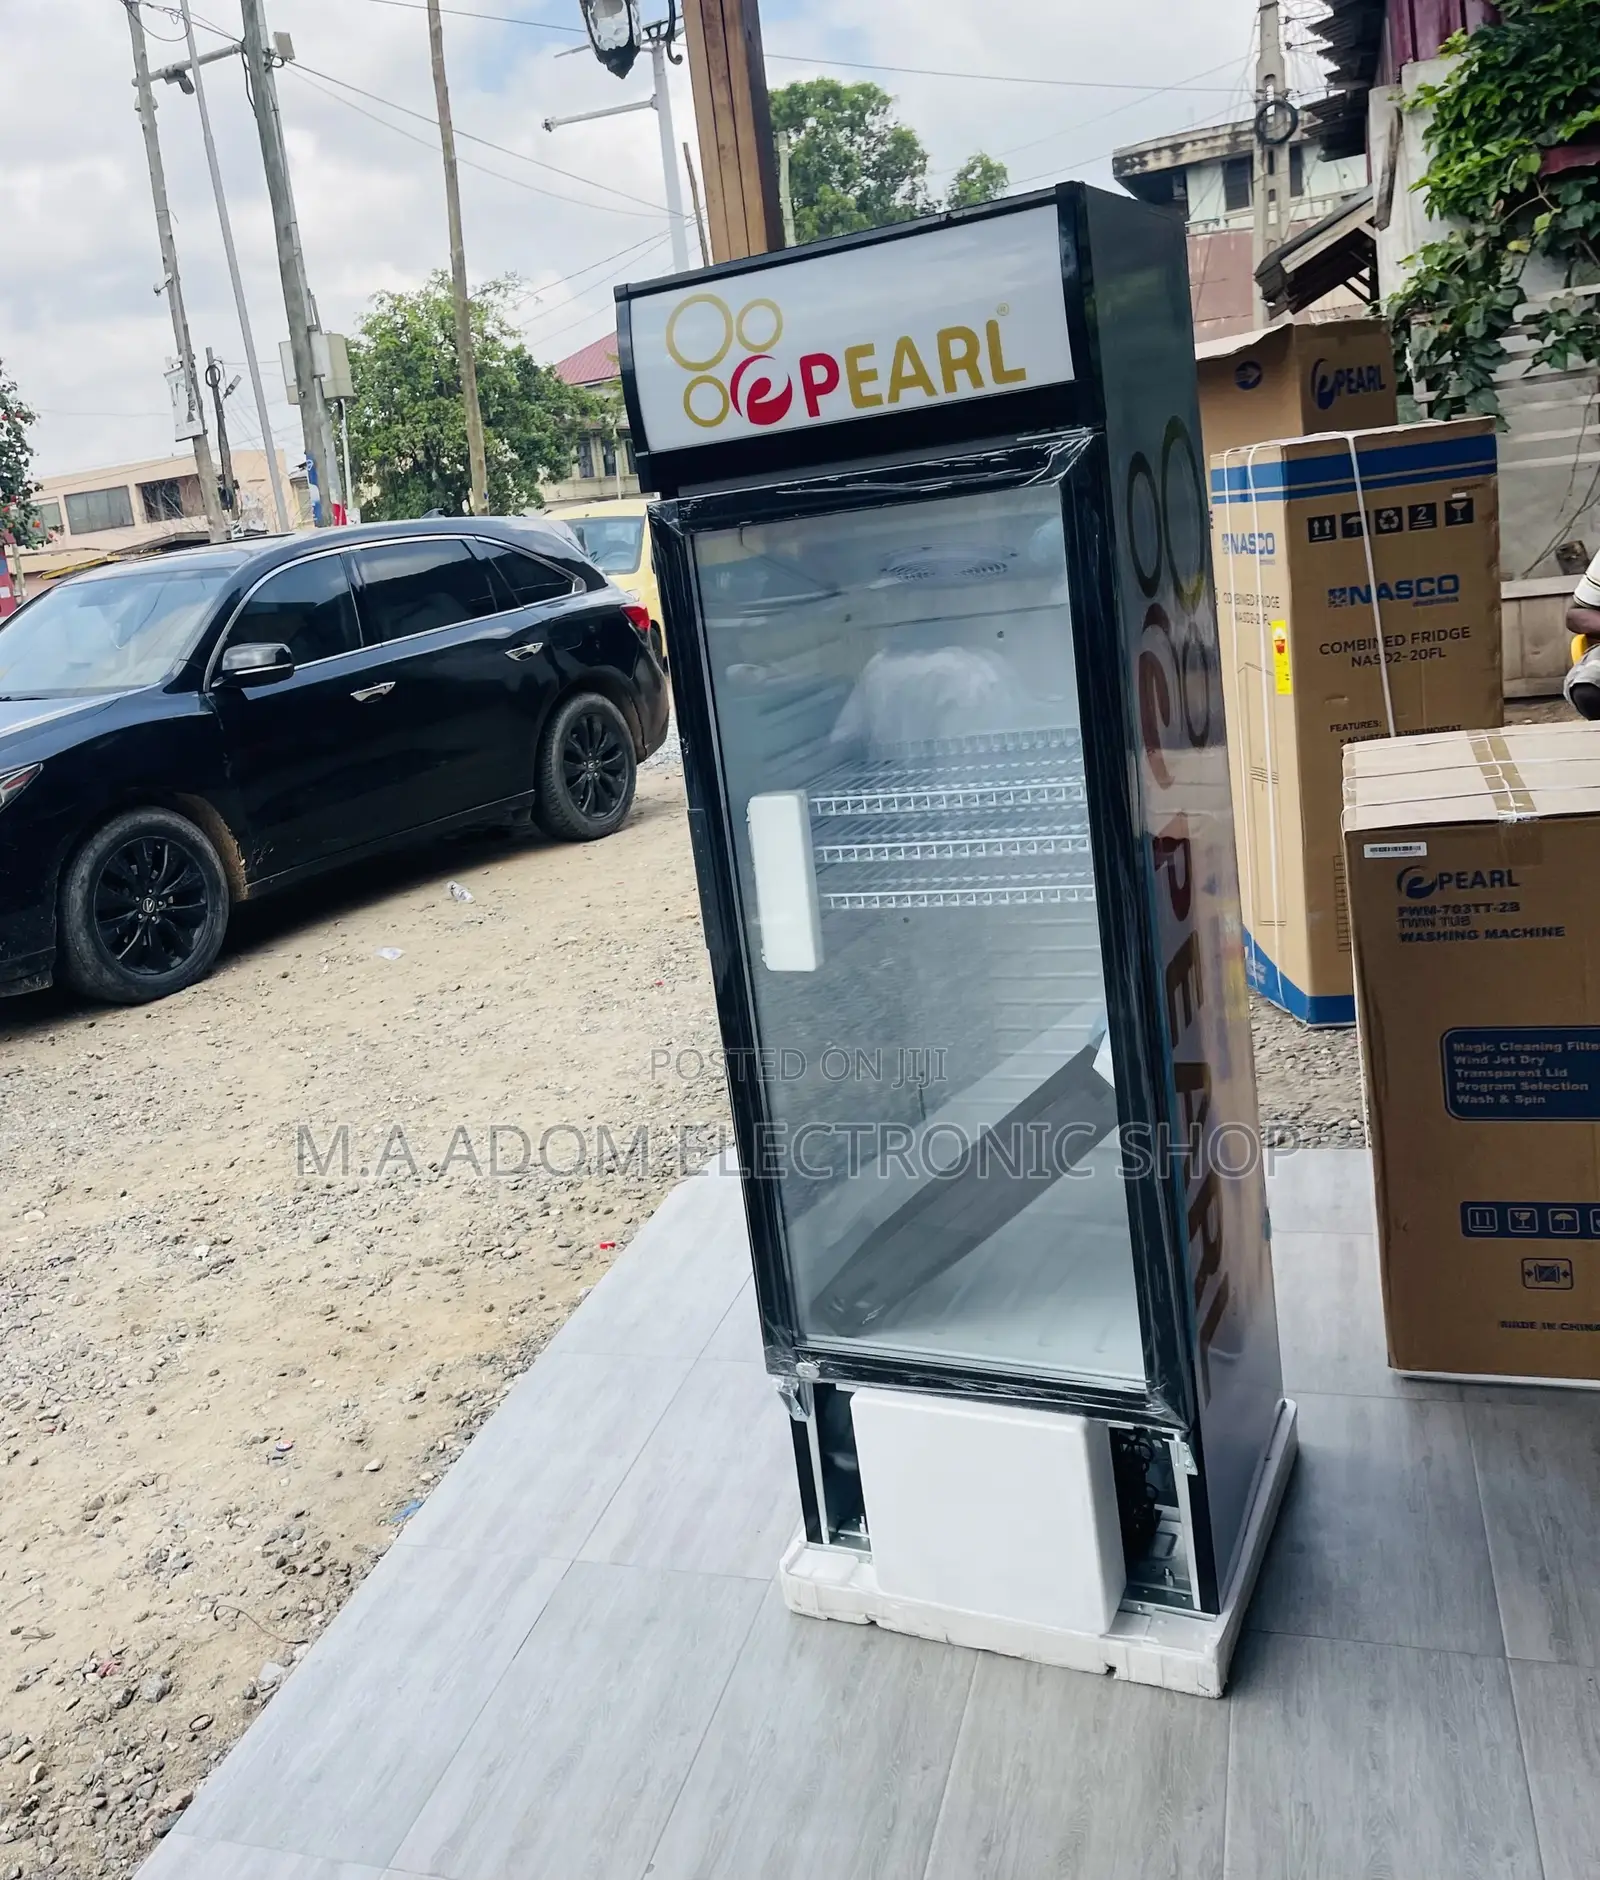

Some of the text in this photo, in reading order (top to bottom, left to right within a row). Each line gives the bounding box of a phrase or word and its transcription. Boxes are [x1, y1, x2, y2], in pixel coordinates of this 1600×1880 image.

[799, 319, 1027, 417] PEARL
[1231, 533, 1276, 555] NASCO
[1350, 574, 1460, 606] NASCO
[1411, 626, 1472, 645] FRIDGE
[1330, 720, 1382, 732] FEATURES:
[1438, 869, 1521, 891] PEARL
[1399, 926, 1566, 943] WASHING MACHINE
[1453, 1042, 1496, 1054] Magic
[1500, 1041, 1562, 1053] Cleaning
[1453, 1055, 1546, 1066] Wind Jet Dry
[1455, 1068, 1568, 1079] Transparent Lid
[1456, 1081, 1589, 1093] Program Selection
[1456, 1094, 1546, 1106] Wash & Spin
